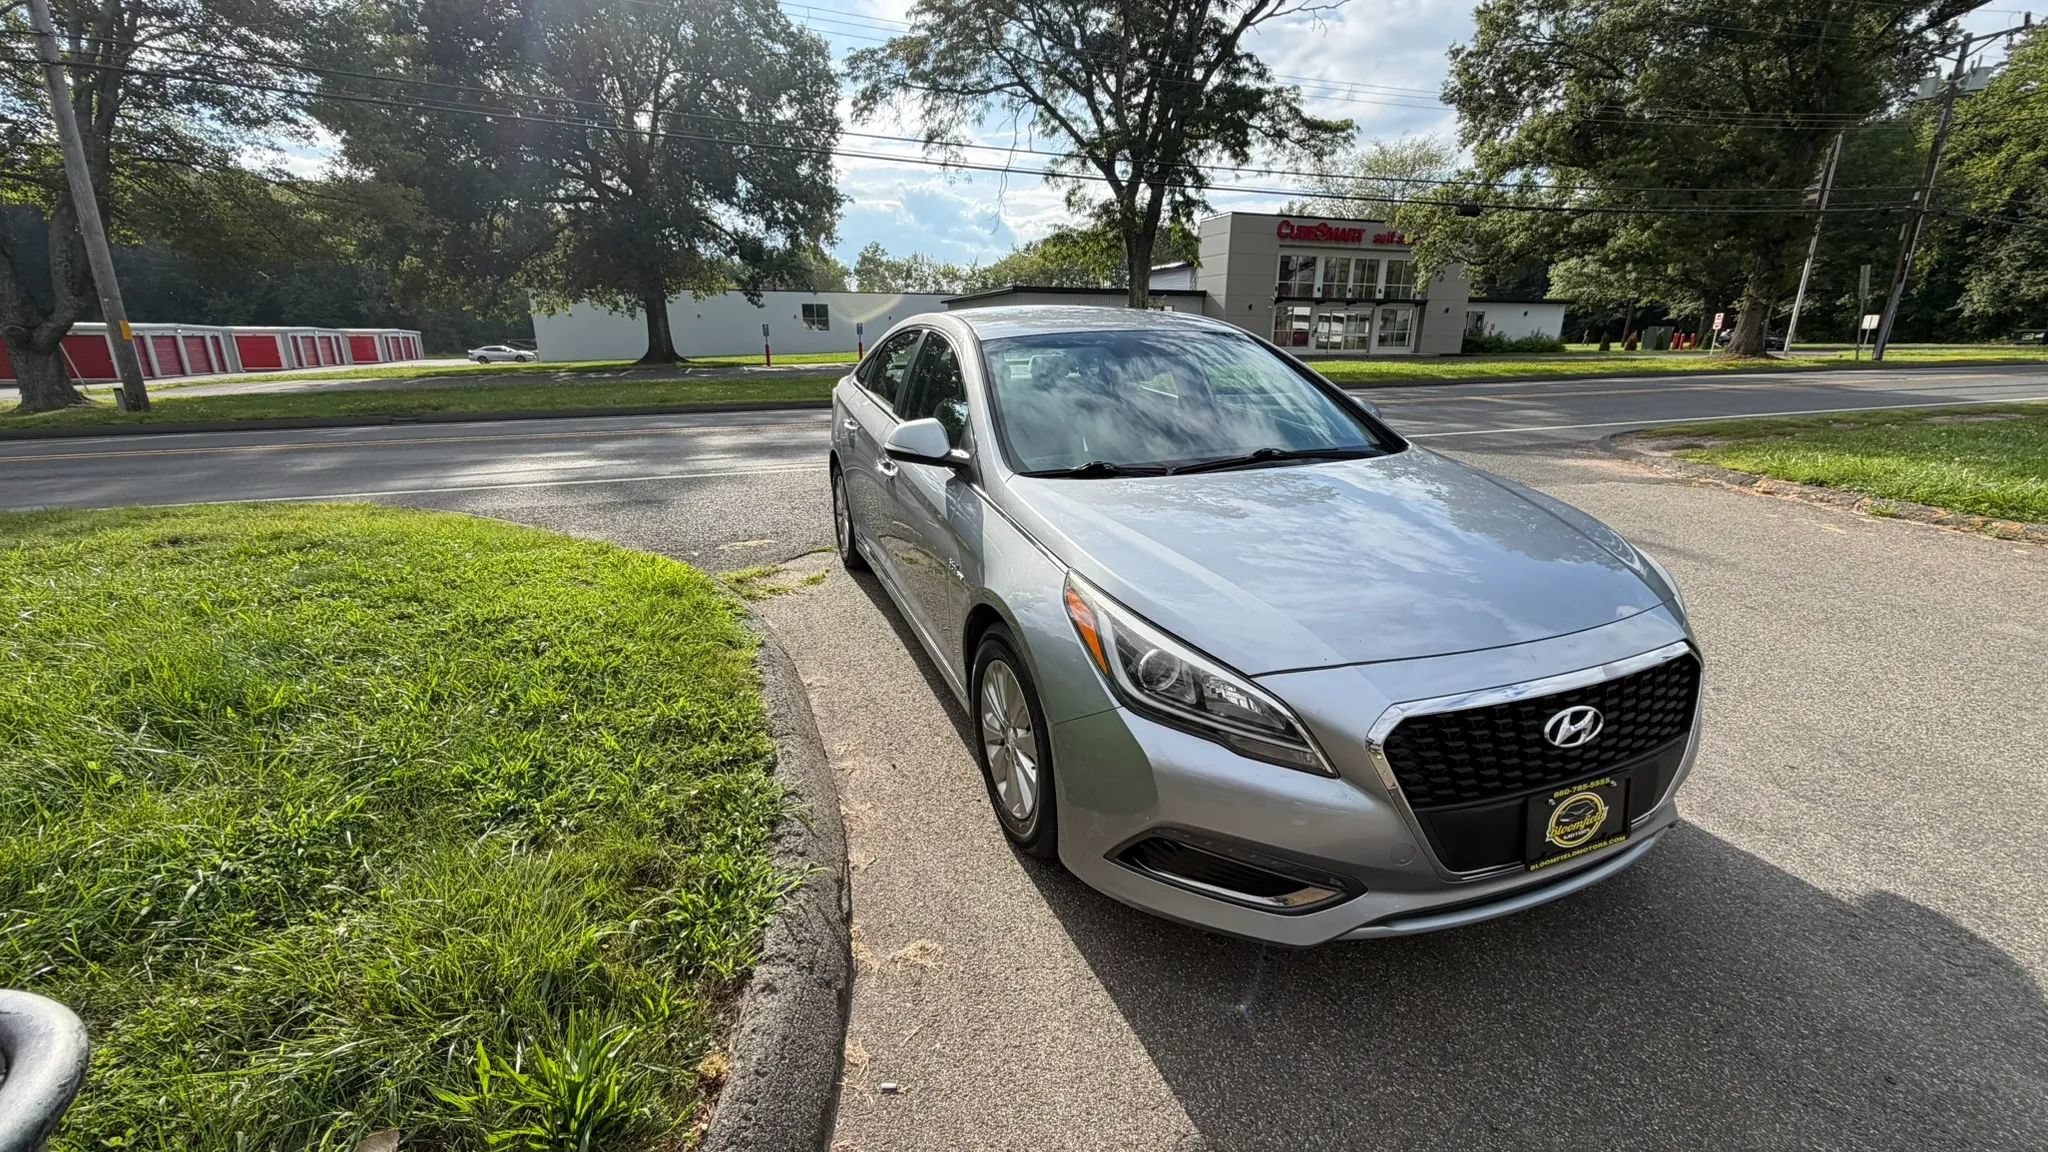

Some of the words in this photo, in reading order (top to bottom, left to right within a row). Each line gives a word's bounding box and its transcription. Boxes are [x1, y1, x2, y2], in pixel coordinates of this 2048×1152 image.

[1553, 777, 1611, 799] 860-785-5555
[1551, 812, 1605, 837] Bloomfield
[1563, 828, 1591, 840] MOTORS
[1530, 836, 1626, 871] BLOOMFIELDMOTORS.COM
